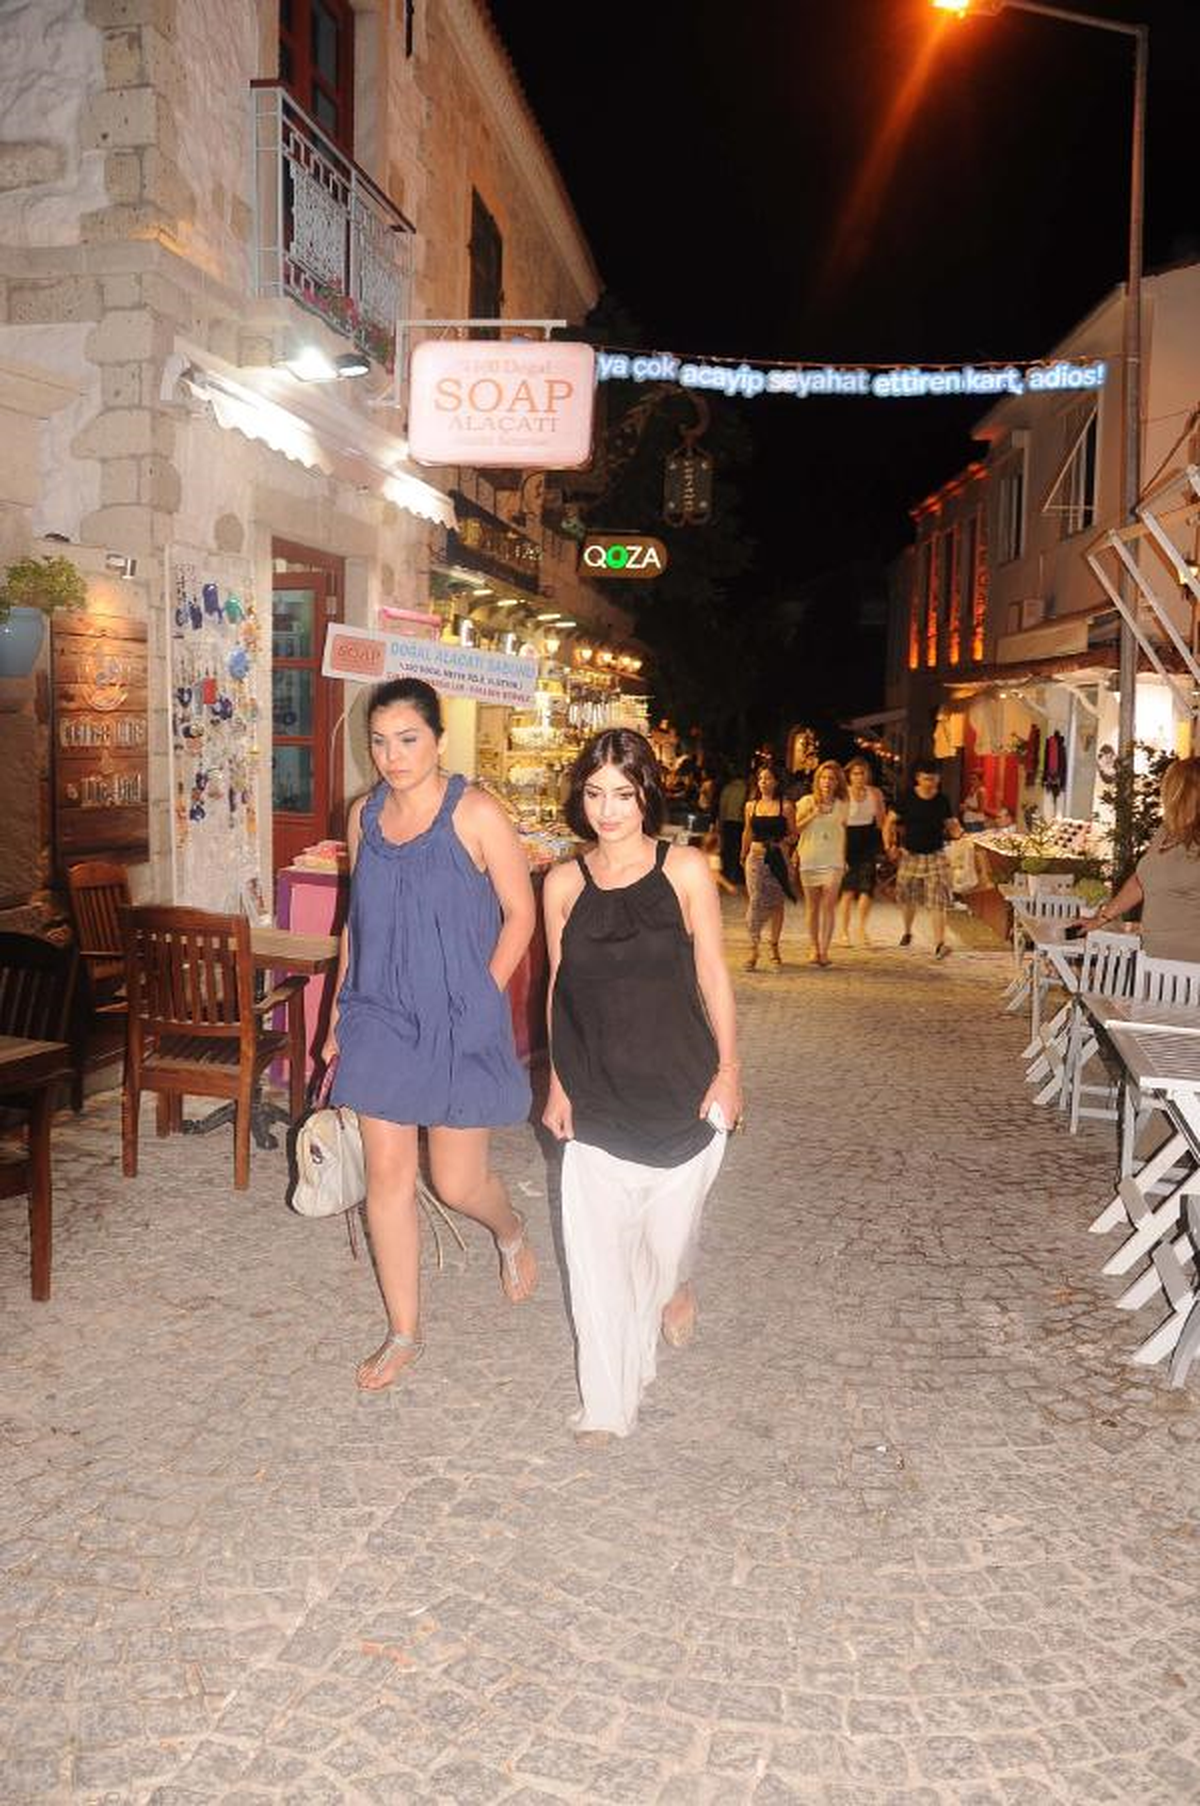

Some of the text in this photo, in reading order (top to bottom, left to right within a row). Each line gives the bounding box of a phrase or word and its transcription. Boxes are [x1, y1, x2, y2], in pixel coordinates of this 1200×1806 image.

[632, 354, 679, 382] çok
[680, 363, 765, 397] acayip
[766, 367, 869, 397] seyahat
[872, 368, 961, 396] ettiren
[1026, 362, 1106, 391] adios!
[435, 378, 574, 414] SOAP
[583, 543, 662, 570] QOZA
[337, 643, 381, 666] SOAP
